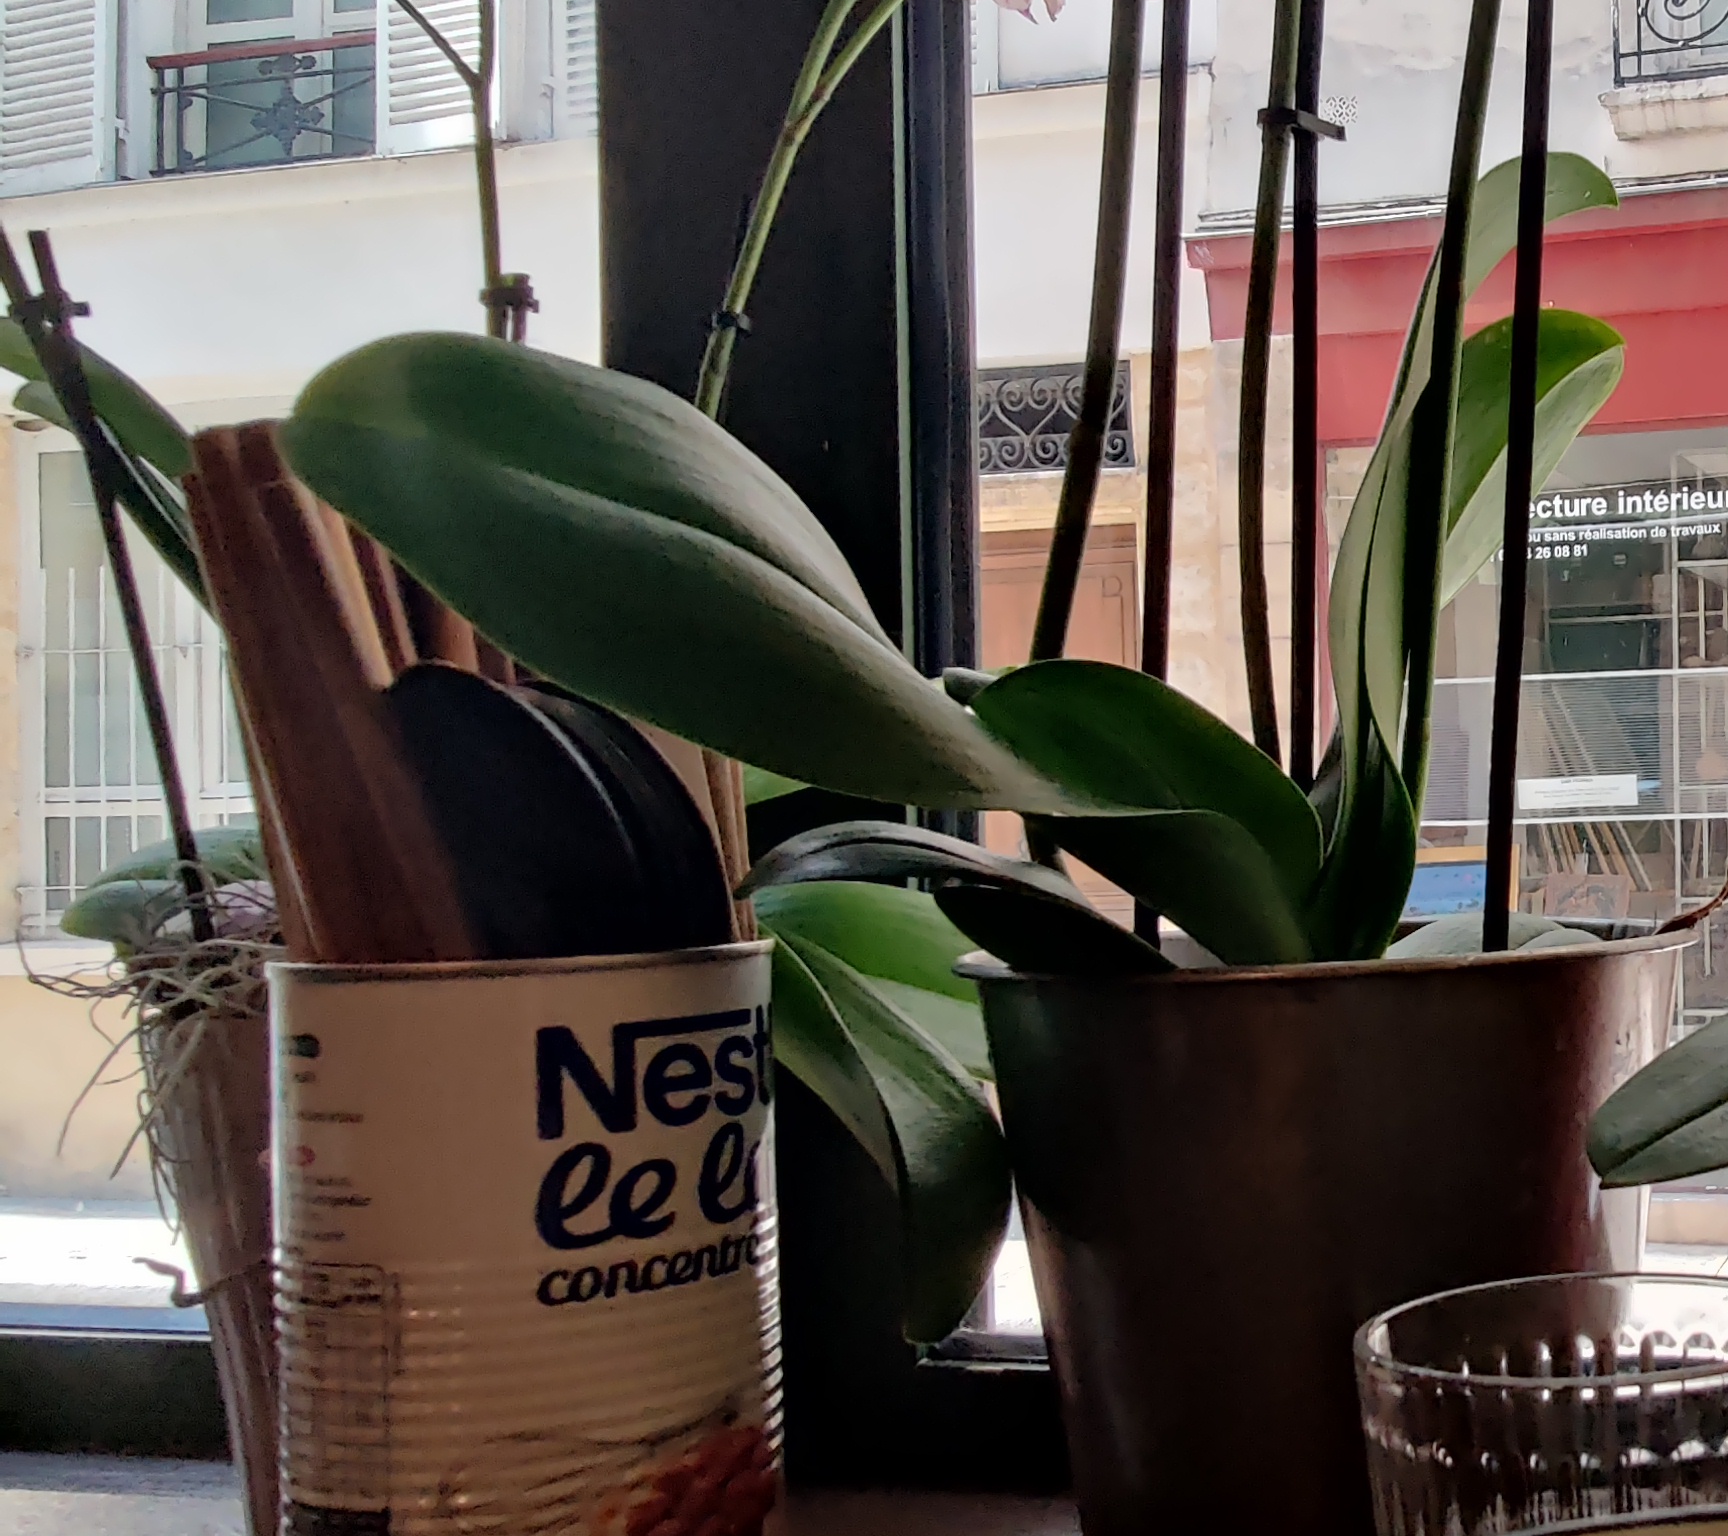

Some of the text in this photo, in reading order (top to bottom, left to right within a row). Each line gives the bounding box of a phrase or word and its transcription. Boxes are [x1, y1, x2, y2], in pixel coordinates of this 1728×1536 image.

[1544, 530, 1576, 542] sans
[1579, 524, 1647, 540] réalisation
[1650, 526, 1667, 539] de
[1671, 522, 1722, 538] travaux
[1535, 545, 1551, 559] 26
[1554, 545, 1571, 559] 08
[1573, 544, 1588, 557] 81
[535, 1002, 773, 1140] Nest
